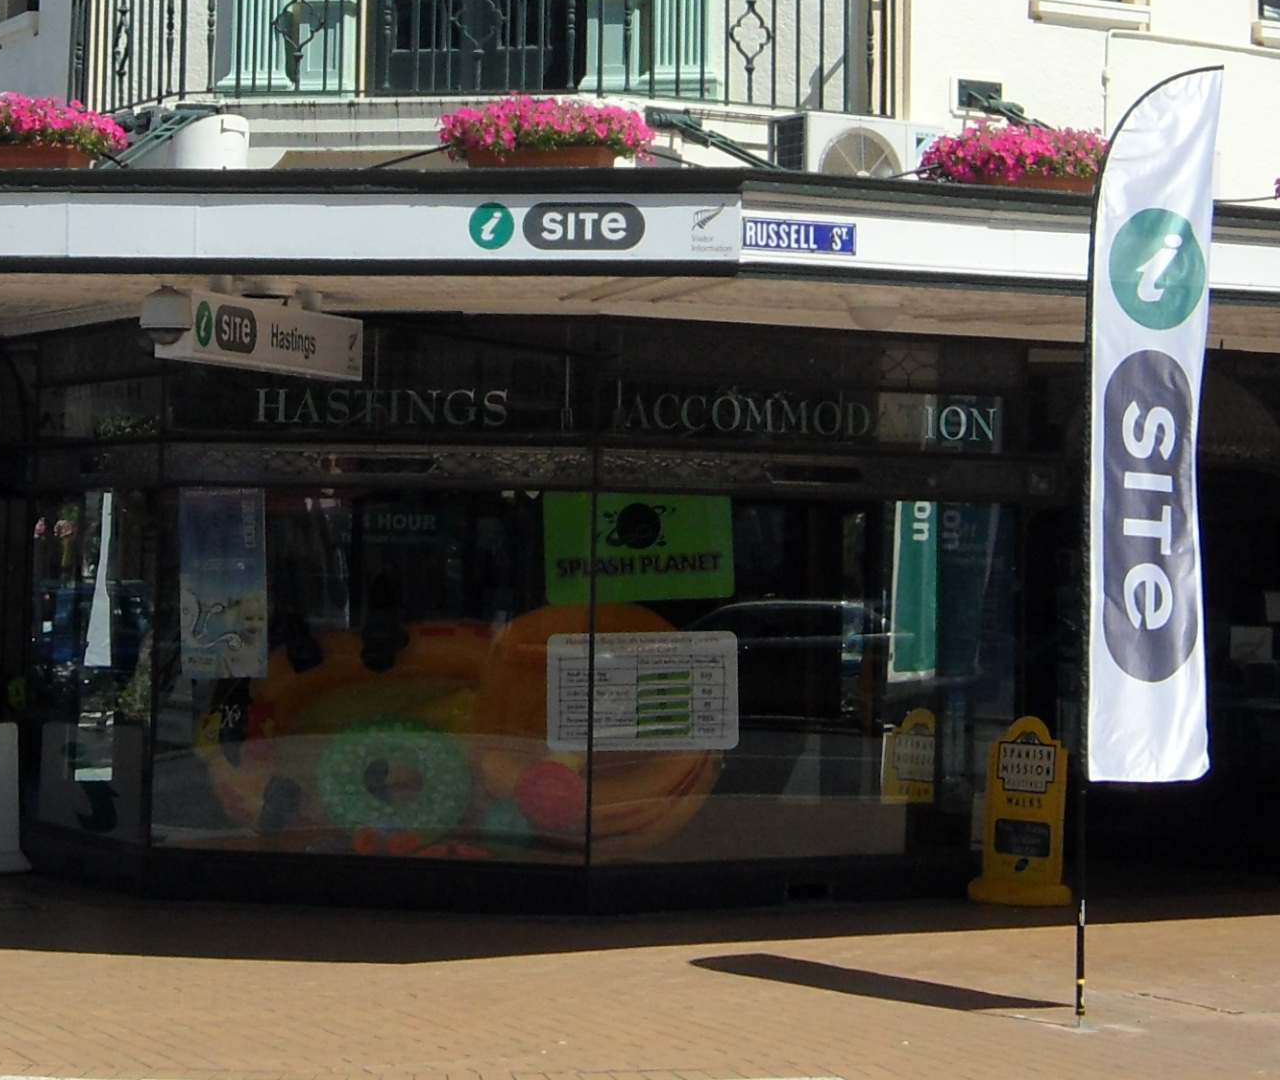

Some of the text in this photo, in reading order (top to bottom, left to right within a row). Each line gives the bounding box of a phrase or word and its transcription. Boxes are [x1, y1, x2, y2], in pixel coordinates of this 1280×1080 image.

[745, 222, 818, 250] RUSSELL
[270, 322, 317, 360] Hastings
[255, 387, 509, 427] HASTINGS
[377, 512, 437, 530] HOUR
[556, 553, 723, 577] SPLASH PLANET
[1002, 745, 1053, 762] SPANISH
[1002, 763, 1052, 778] MISSION
[1006, 797, 1043, 809] WALKS
